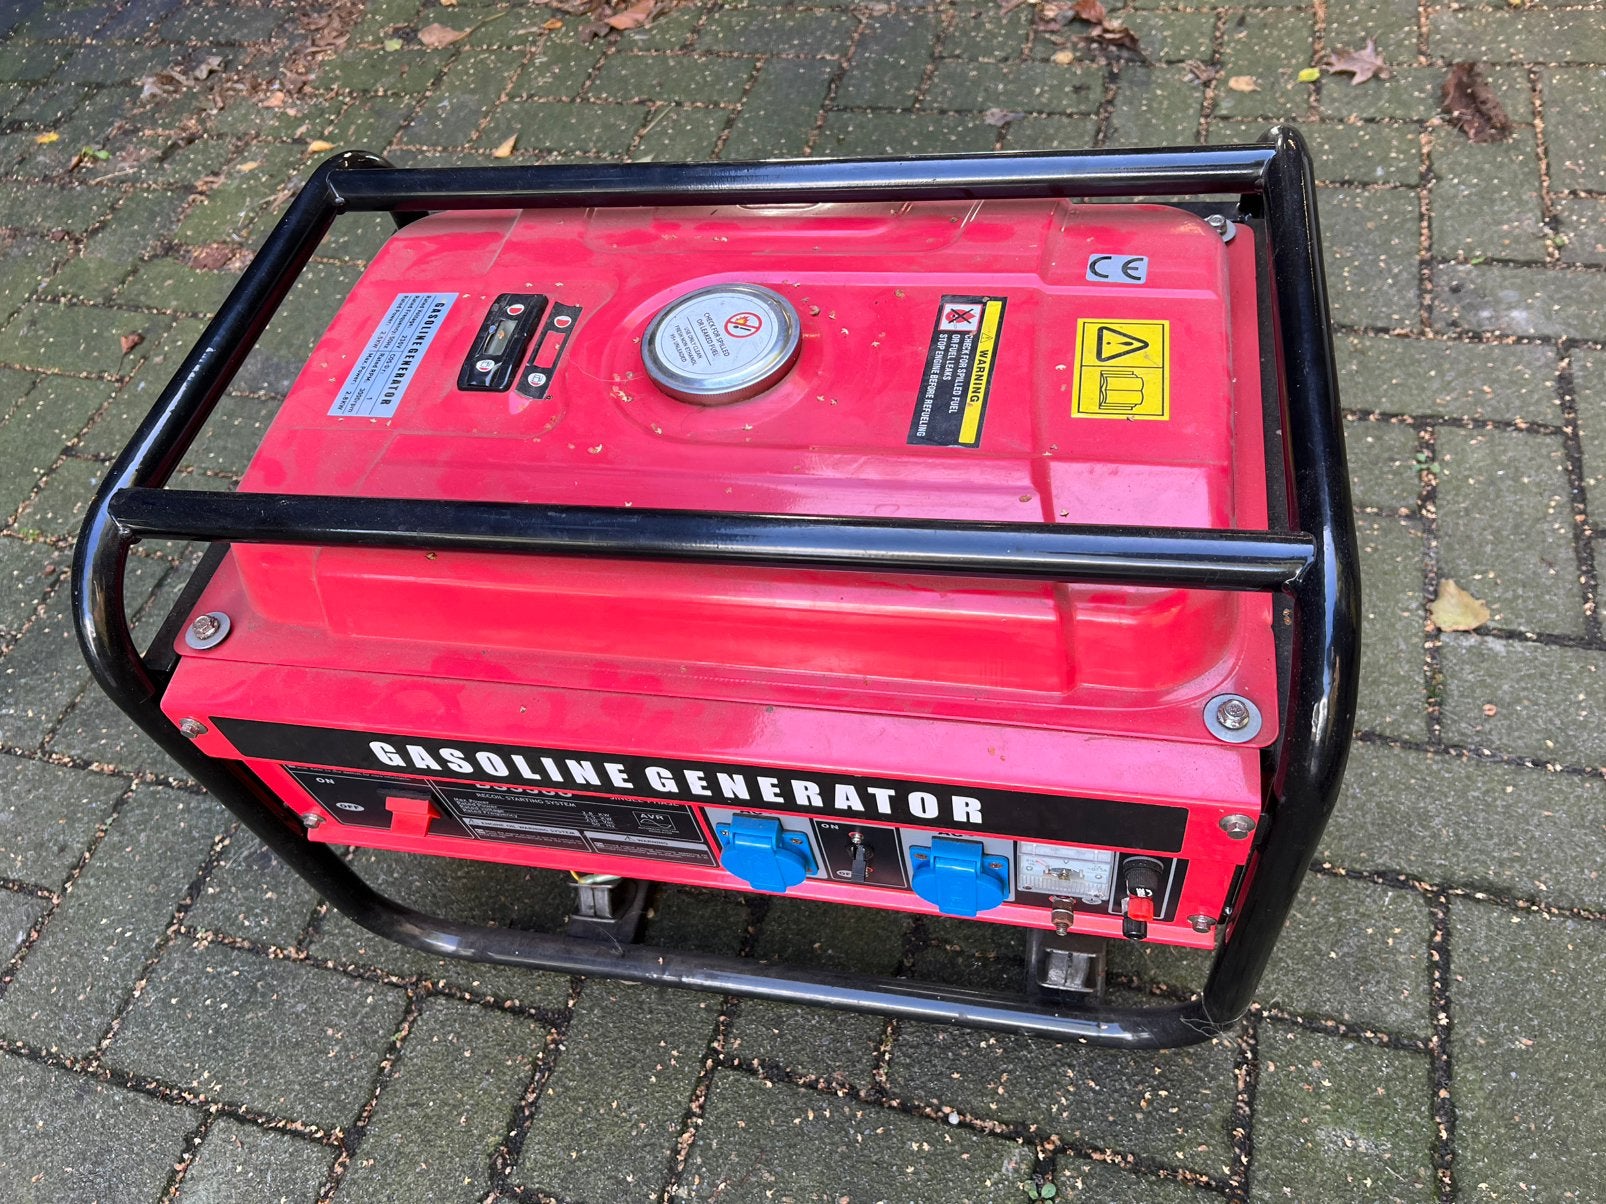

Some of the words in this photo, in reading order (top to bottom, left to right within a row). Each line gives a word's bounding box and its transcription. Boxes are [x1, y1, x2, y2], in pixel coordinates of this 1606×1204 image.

[1089, 256, 1144, 280] CE
[411, 302, 445, 345] GASOLINE
[704, 312, 715, 329] CHECK
[711, 328, 720, 337] FOR
[716, 337, 730, 356] SPILLED
[688, 335, 696, 345] ONLY
[693, 346, 702, 359] CLEAN
[700, 326, 713, 344] LEAKED
[709, 344, 718, 357] FUEL
[936, 333, 947, 349] STOP
[950, 334, 960, 343] OR
[961, 334, 973, 354] CHECK
[371, 352, 385, 367] Rated
[674, 341, 686, 362] UNLEADED
[685, 347, 697, 365] ETHANOL
[930, 351, 943, 373] ENGINE
[947, 344, 958, 359] FUEL
[958, 354, 968, 367] FOR
[378, 348, 420, 405] GENERATOR
[942, 360, 954, 380] LEAKS
[952, 368, 965, 394] SPILLED
[969, 349, 988, 402] WARNING
[924, 374, 938, 398] BEFORE
[948, 396, 959, 413] FUEL
[916, 399, 932, 436] REFUELING
[368, 740, 634, 790] GASOLINE
[650, 766, 984, 824] GENERATOR
[506, 796, 544, 804] STARTING
